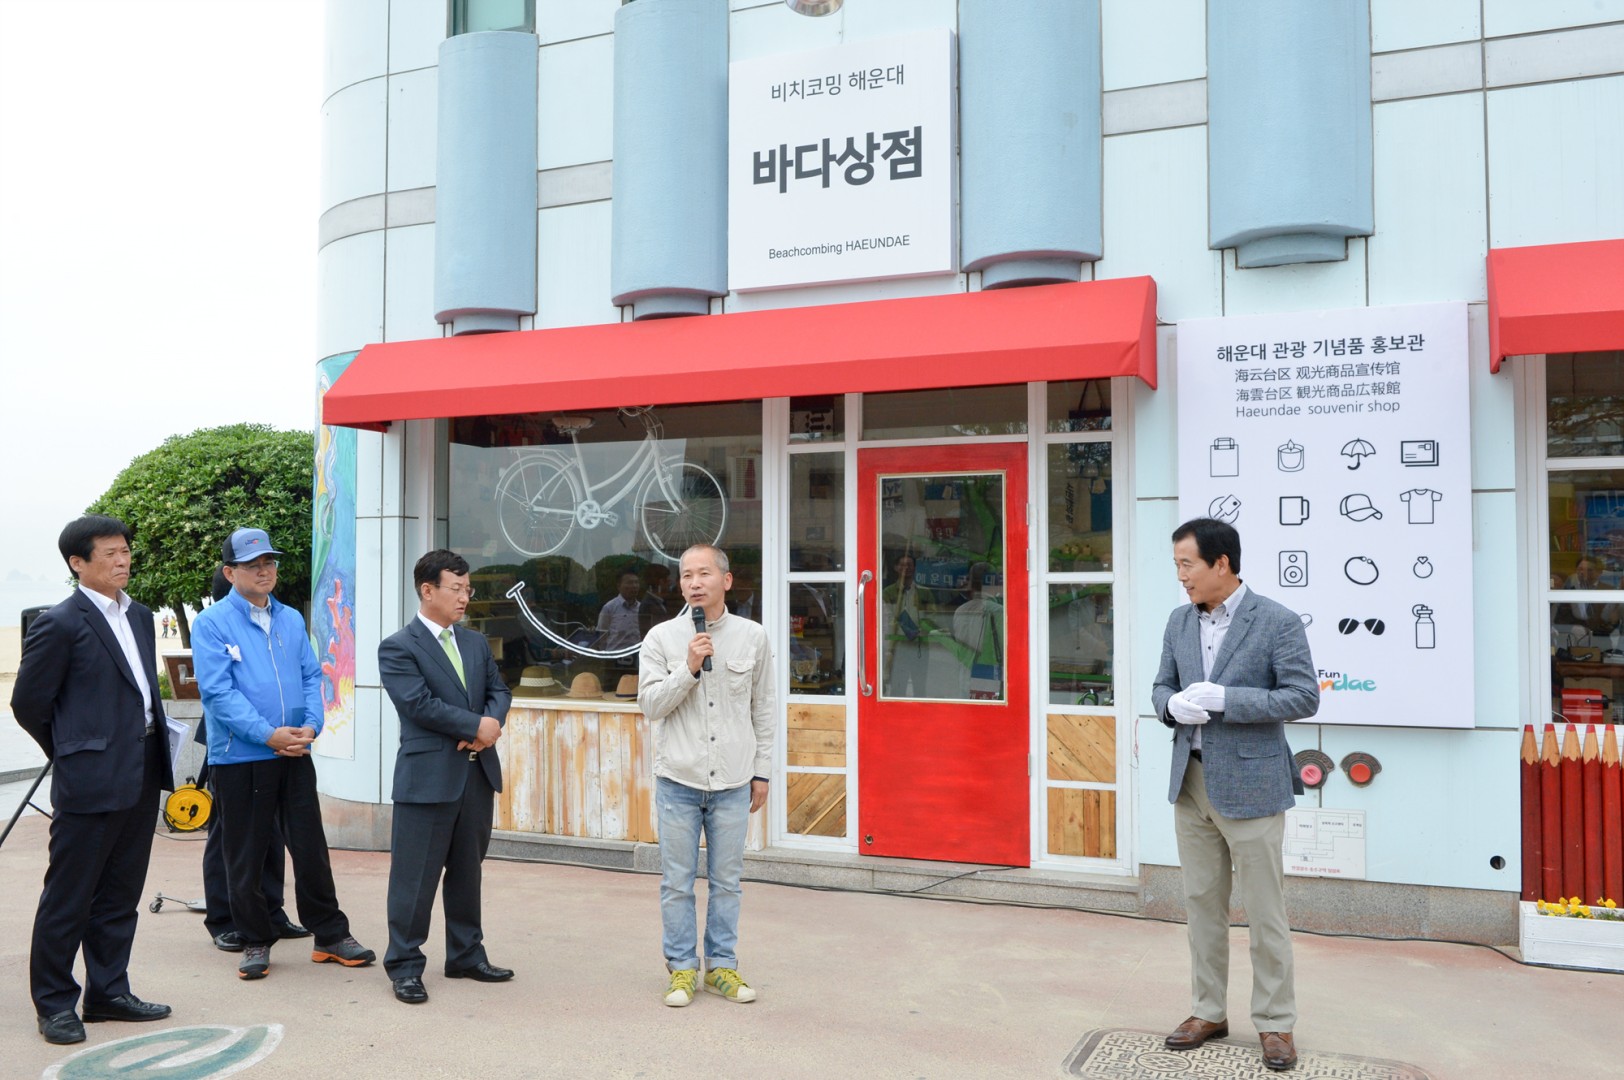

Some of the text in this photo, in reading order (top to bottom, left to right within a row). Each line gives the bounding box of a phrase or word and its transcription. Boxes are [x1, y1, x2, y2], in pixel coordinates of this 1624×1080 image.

[772, 64, 903, 102] 비치코밍 해운대
[753, 126, 922, 194] 바다상점
[769, 235, 909, 259] Beachcombing HAEUNDAE
[1217, 334, 1425, 362] 해운대 관광 기념품 홍보관
[1235, 361, 1400, 382] 海云台区 观光商品宣传馆
[1236, 381, 1400, 401] 海雲台区 観光商品広報館
[1237, 400, 1400, 417] Haeundae souvenir shop
[1318, 669, 1340, 678] Fun
[1318, 673, 1376, 691] ndae
